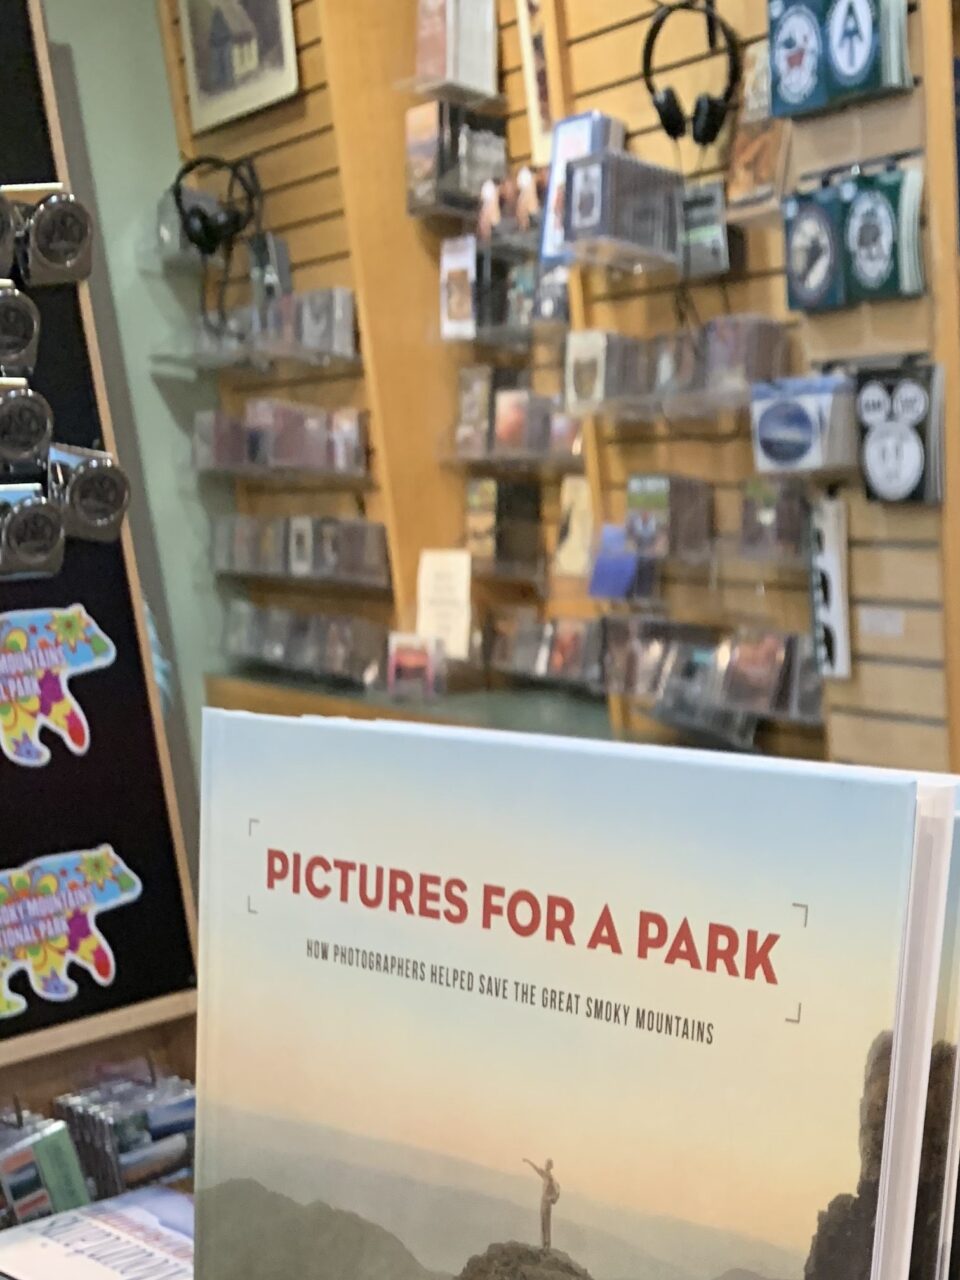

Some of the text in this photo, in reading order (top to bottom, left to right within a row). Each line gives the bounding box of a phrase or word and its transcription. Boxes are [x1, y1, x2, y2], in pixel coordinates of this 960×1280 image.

[265, 847, 782, 986] PICTURES FOR A PARK
[305, 937, 715, 1046] HOW PHOTOGRAPHERS HELPED SAVE THE GREAT SMOKY MOUNTAINS
